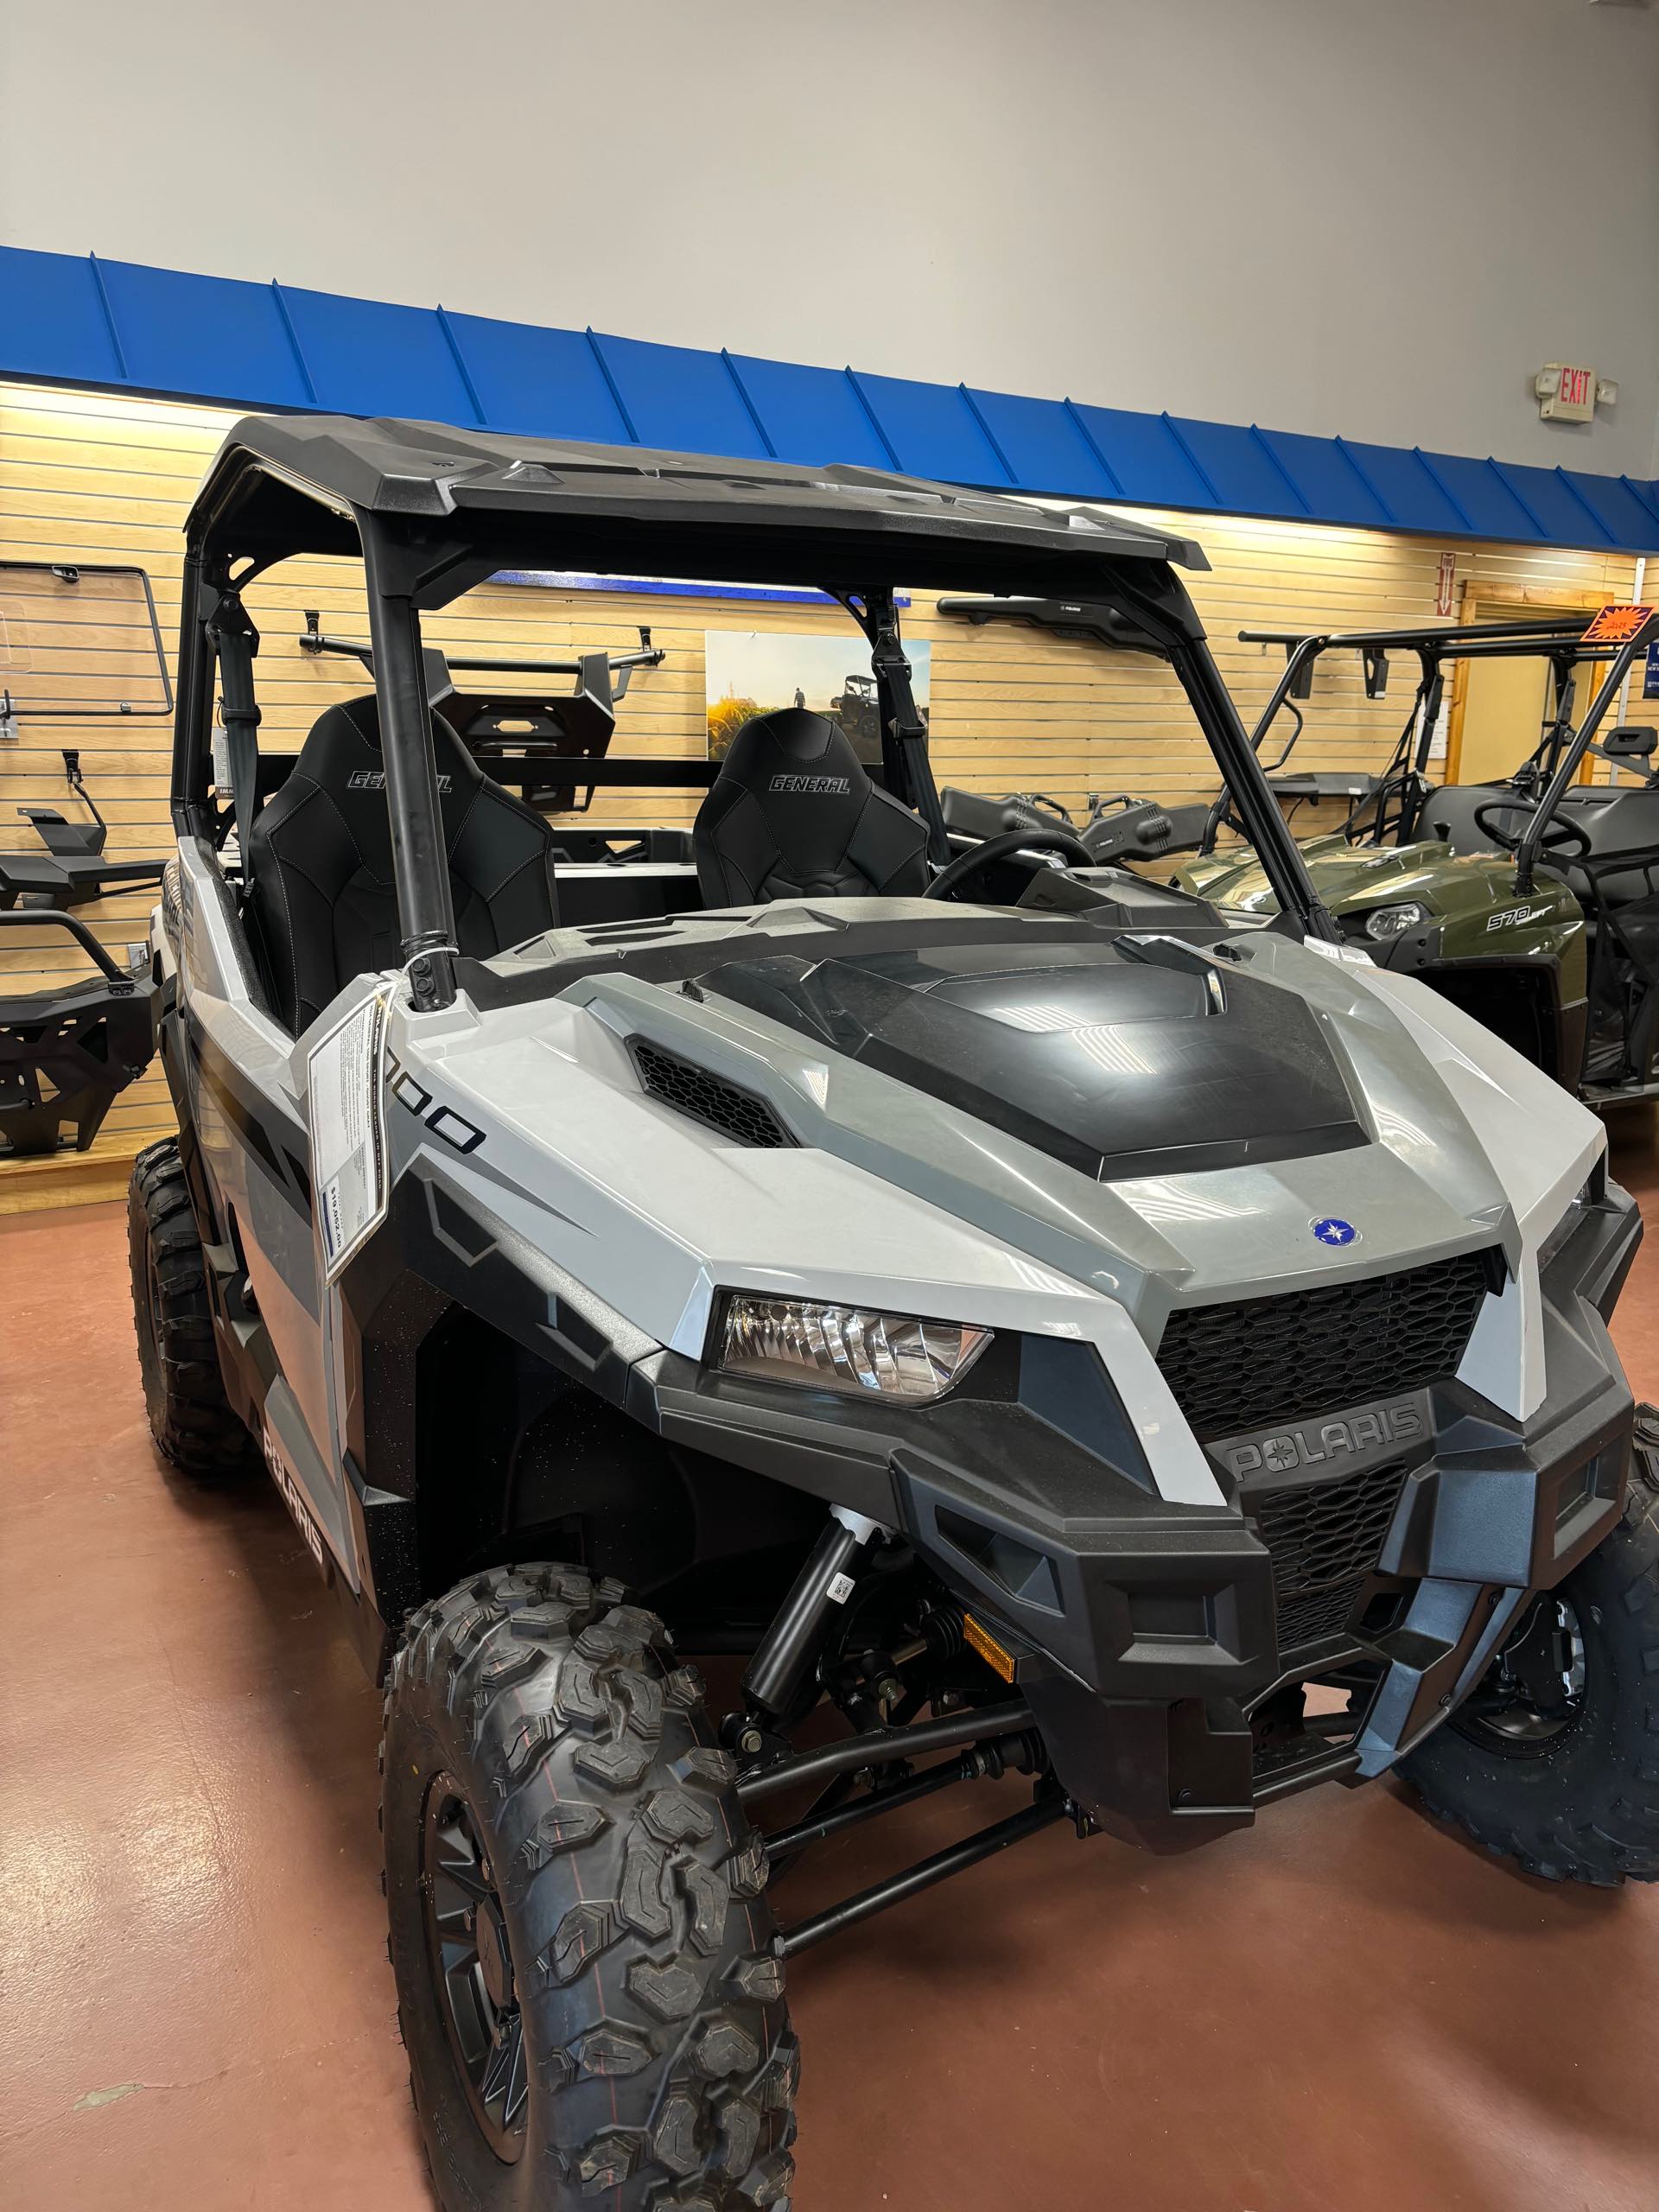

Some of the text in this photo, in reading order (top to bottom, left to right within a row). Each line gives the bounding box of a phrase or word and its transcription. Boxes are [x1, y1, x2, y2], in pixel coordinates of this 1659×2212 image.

[1560, 367, 1591, 404] EXIT
[768, 774, 850, 794] GENERAL
[1486, 906, 1530, 931] 570
[1226, 1402, 1424, 1483] POLARIS
[263, 1426, 323, 1565] POLARIS
